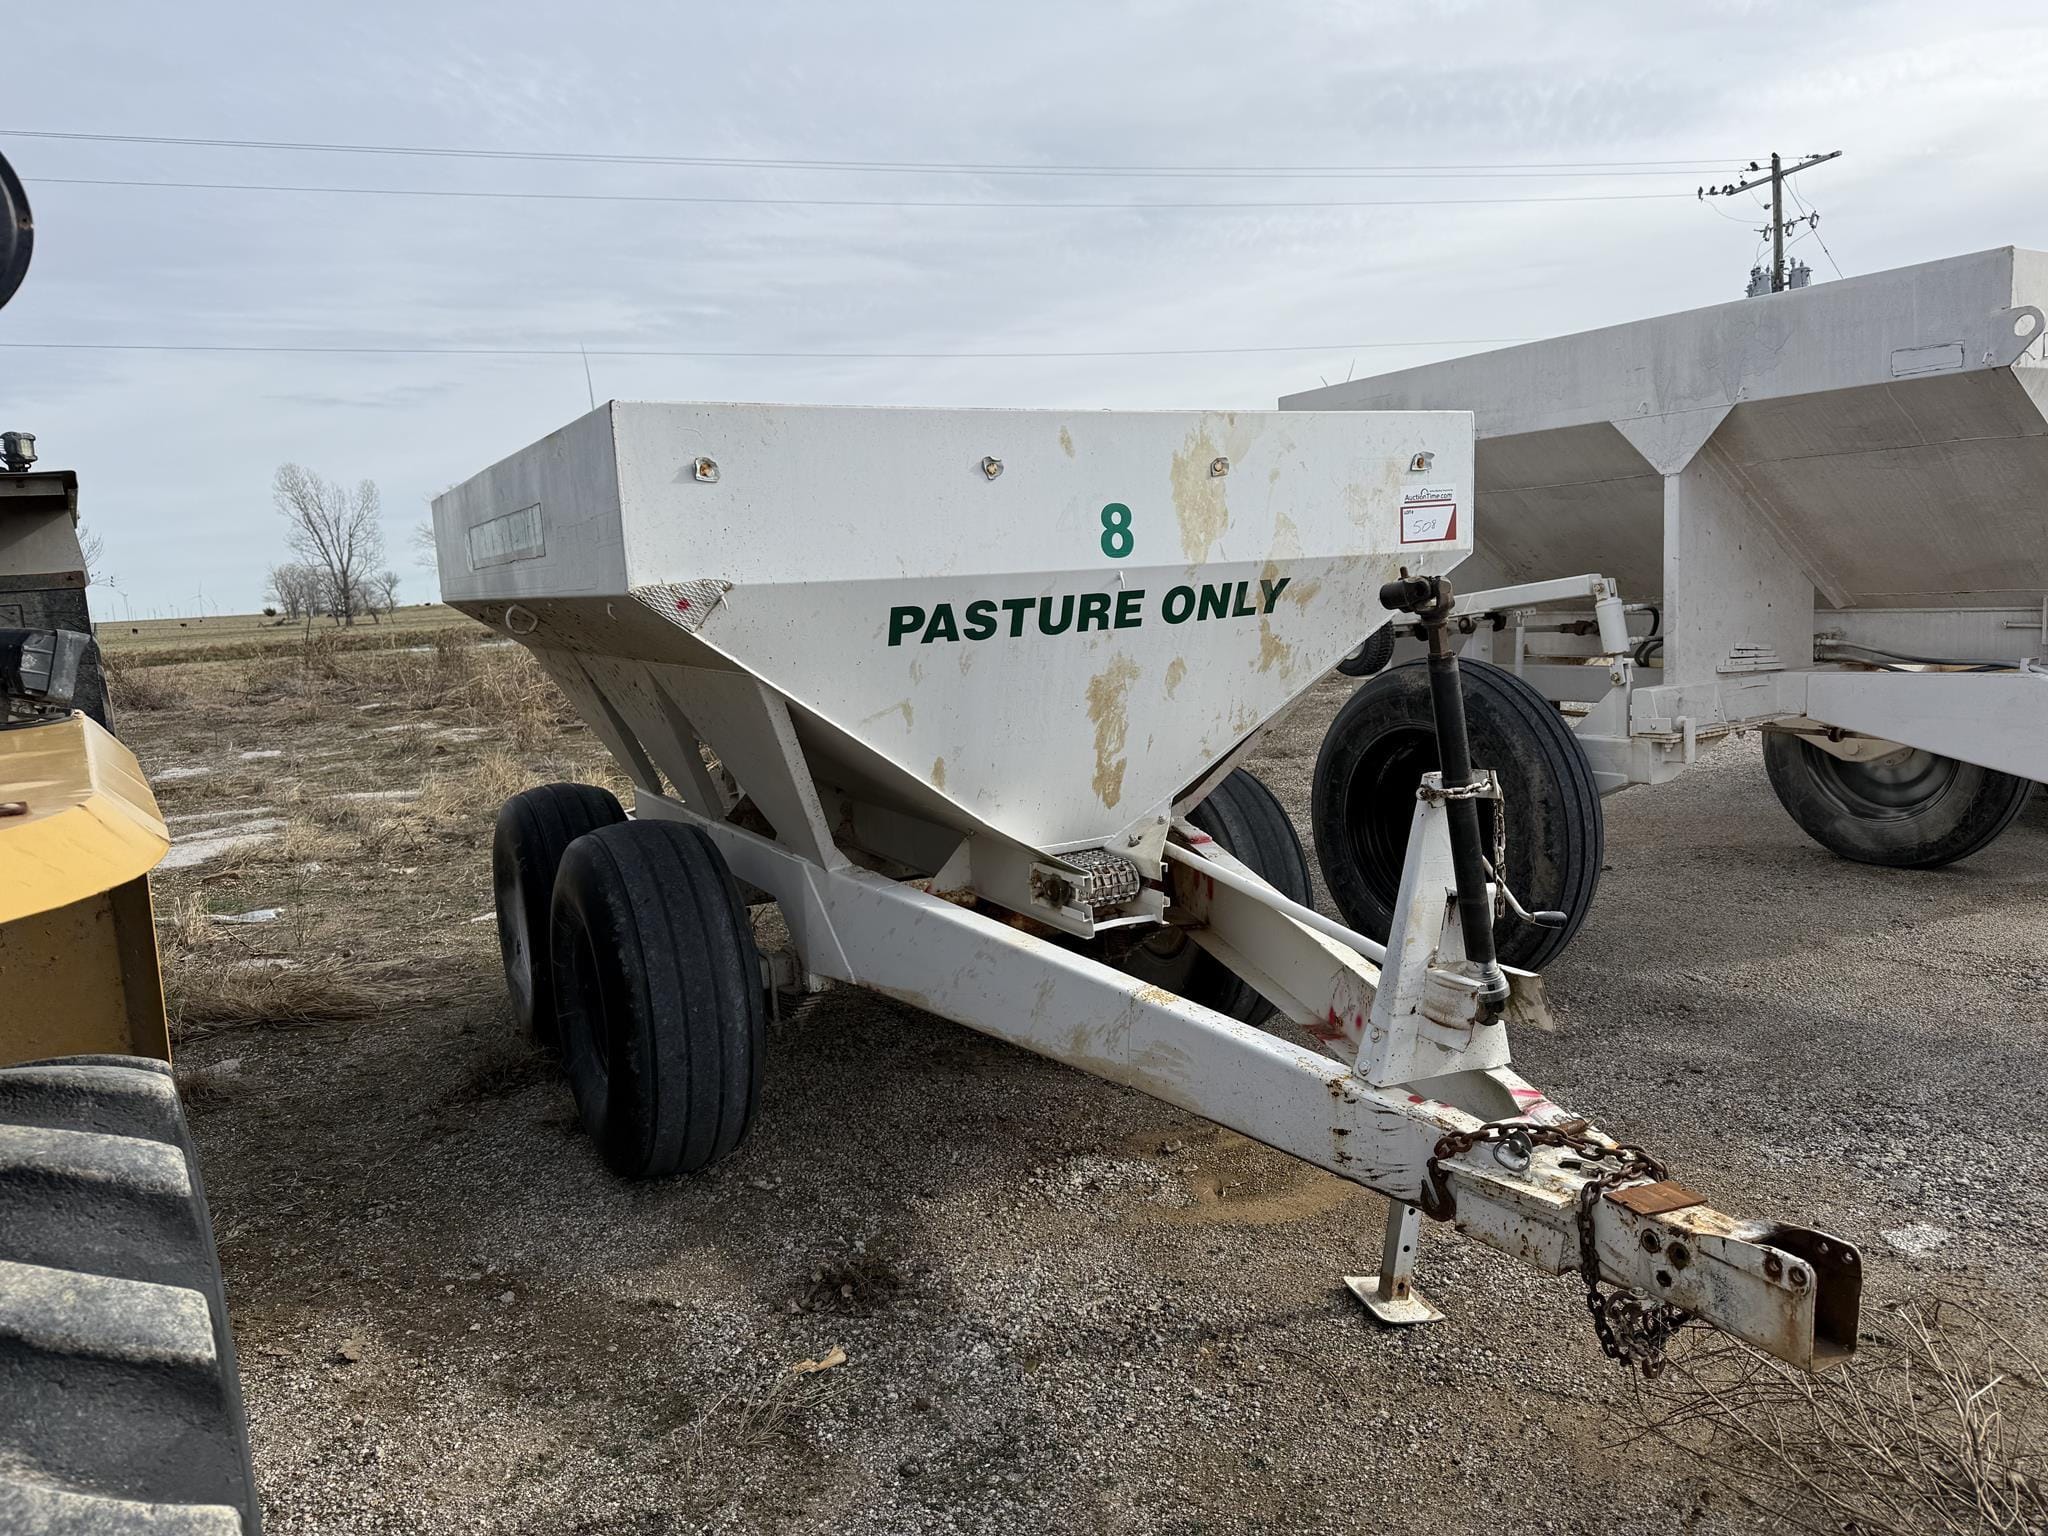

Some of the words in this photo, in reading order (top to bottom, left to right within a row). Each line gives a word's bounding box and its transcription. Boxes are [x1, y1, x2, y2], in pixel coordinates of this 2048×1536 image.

[1404, 492, 1453, 501] AuctionTime.com
[1100, 502, 1134, 559] 8
[1413, 519, 1437, 535] 508
[888, 589, 1146, 647] PASTURE
[1161, 577, 1291, 625] ONLY
